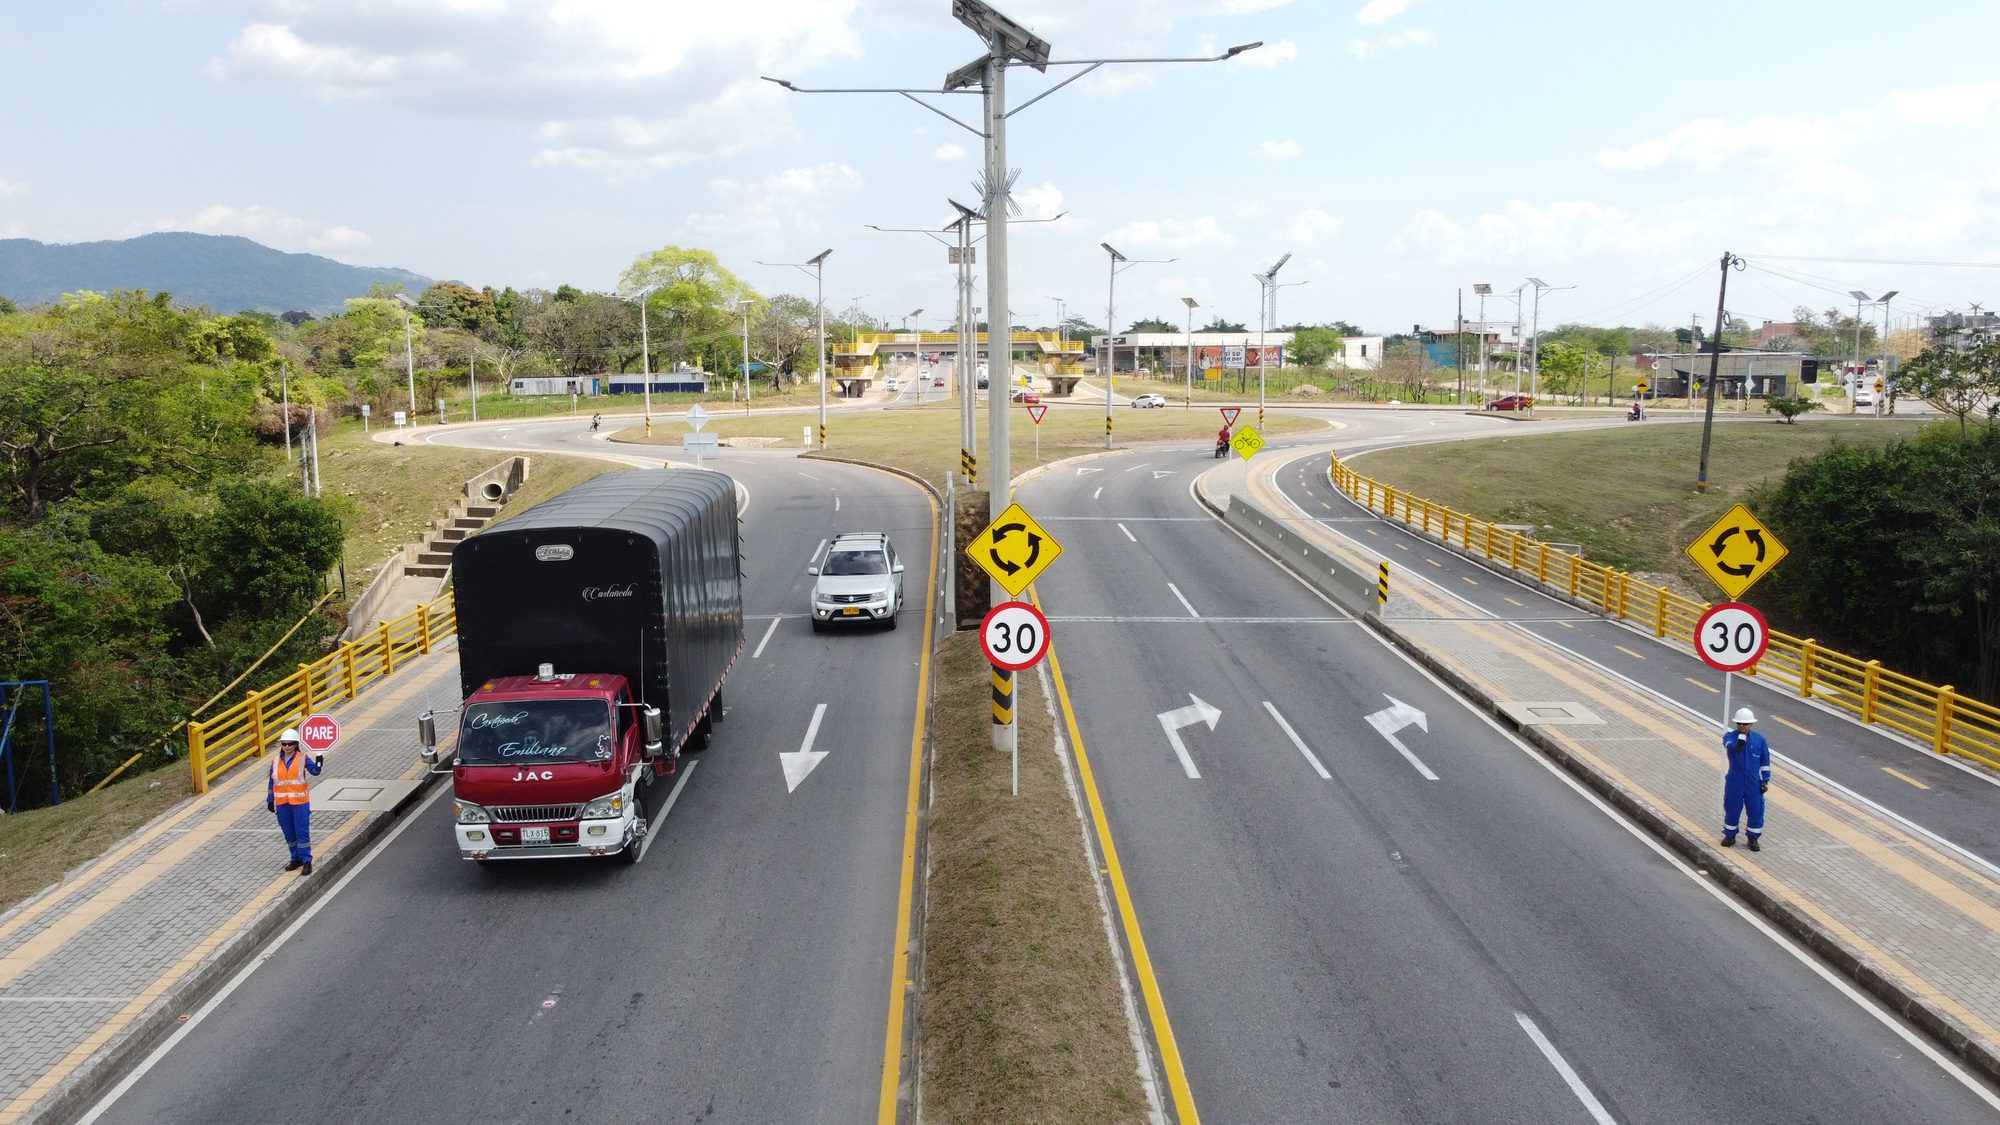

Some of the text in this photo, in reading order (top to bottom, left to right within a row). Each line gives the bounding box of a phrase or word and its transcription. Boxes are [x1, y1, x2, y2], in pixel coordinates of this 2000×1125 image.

[993, 622, 1036, 654] 30
[1709, 622, 1755, 654] 30
[305, 726, 334, 740] PARE
[498, 740, 568, 757] Emiliano
[512, 771, 553, 782] JAC
